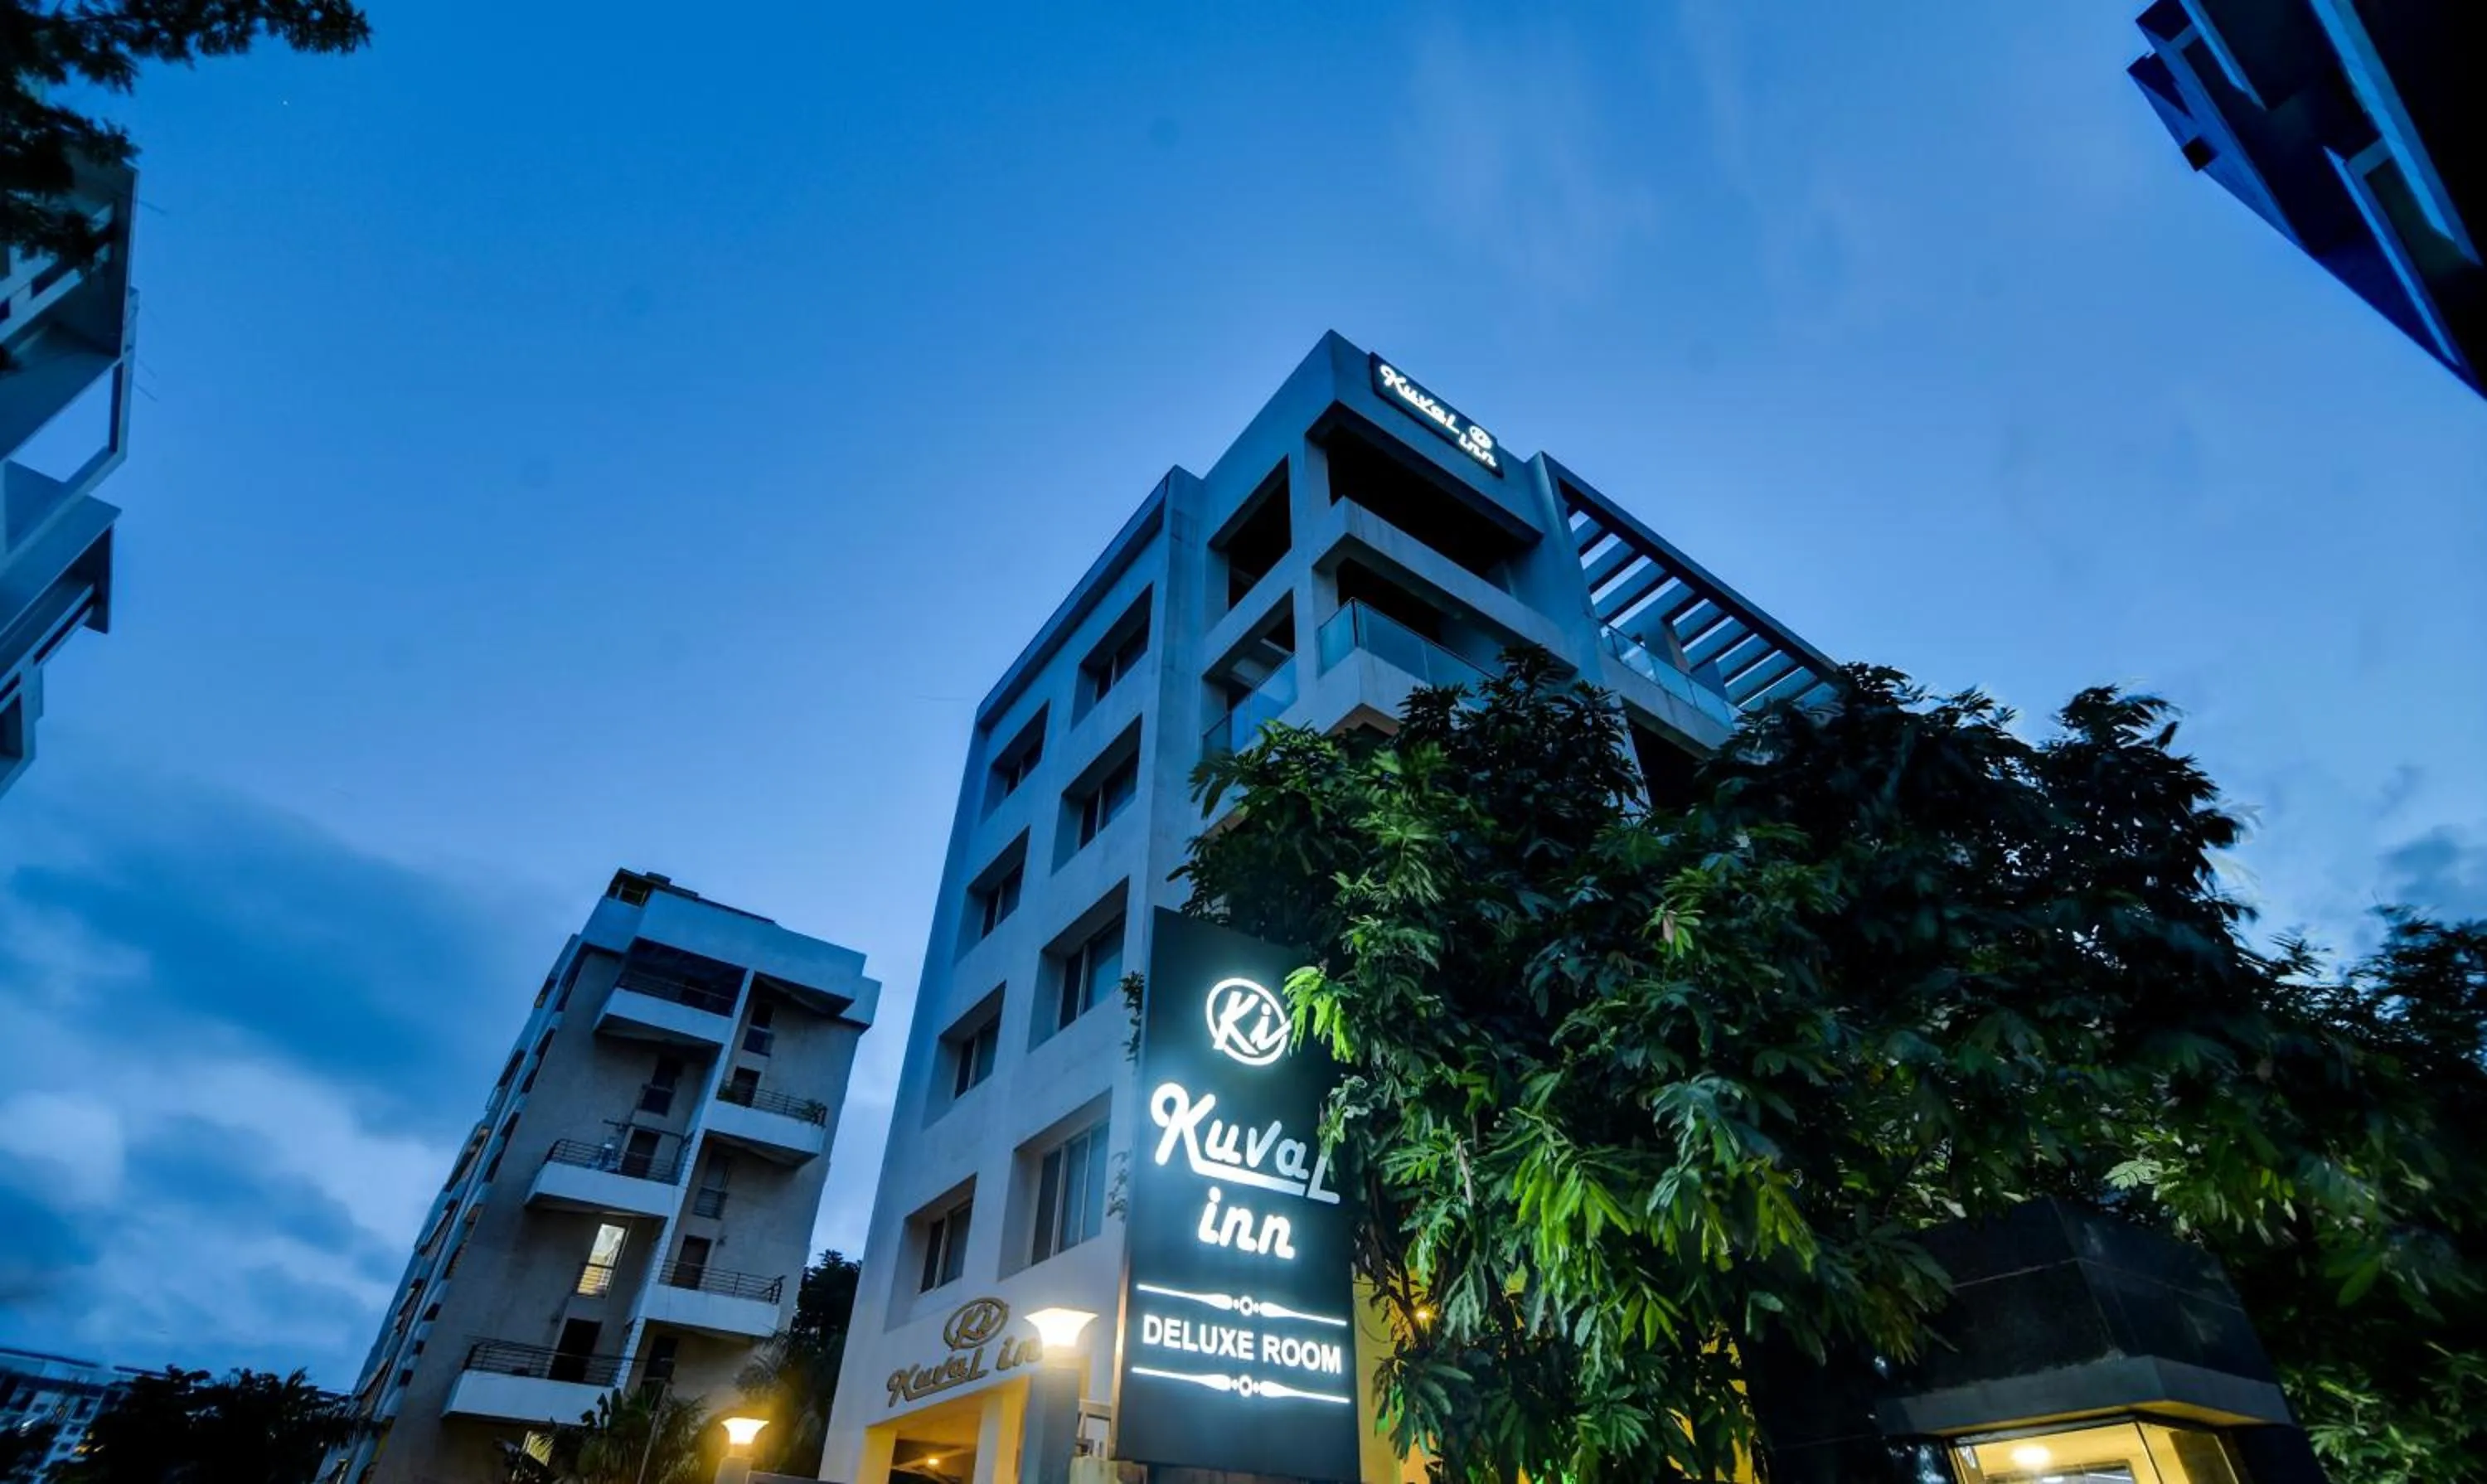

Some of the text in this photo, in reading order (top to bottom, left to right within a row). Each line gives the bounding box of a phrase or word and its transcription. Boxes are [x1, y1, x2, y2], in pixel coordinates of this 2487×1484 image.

[1198, 1186, 1296, 1260] inn
[996, 1335, 1043, 1371] in
[1142, 1313, 1342, 1375] DELUXE ROOM
